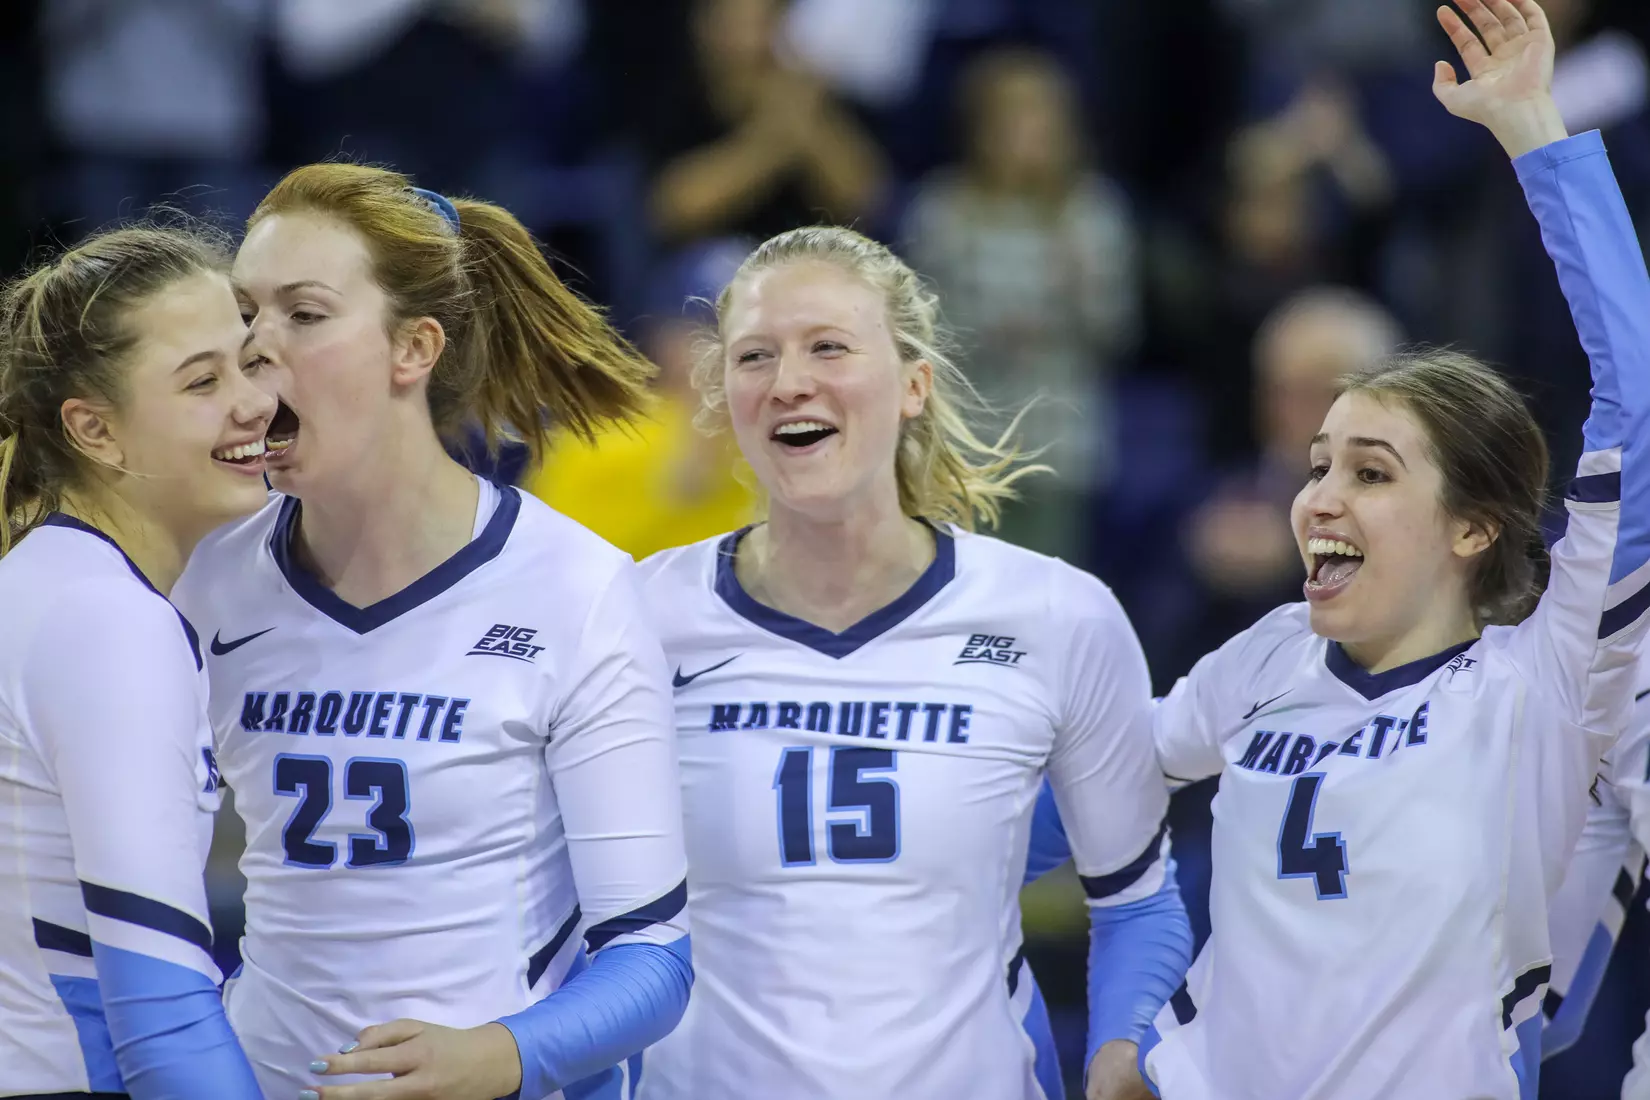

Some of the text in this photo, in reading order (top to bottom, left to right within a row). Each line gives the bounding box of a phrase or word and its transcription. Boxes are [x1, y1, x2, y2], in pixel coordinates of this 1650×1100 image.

[472, 637, 546, 658] EAST
[484, 623, 538, 643] BIG
[966, 633, 1016, 649] BIG
[958, 647, 1028, 664] EAST
[239, 690, 471, 743] MARQUETTE
[273, 752, 416, 870] 23
[772, 745, 901, 868] 15
[1276, 771, 1350, 901] 4
